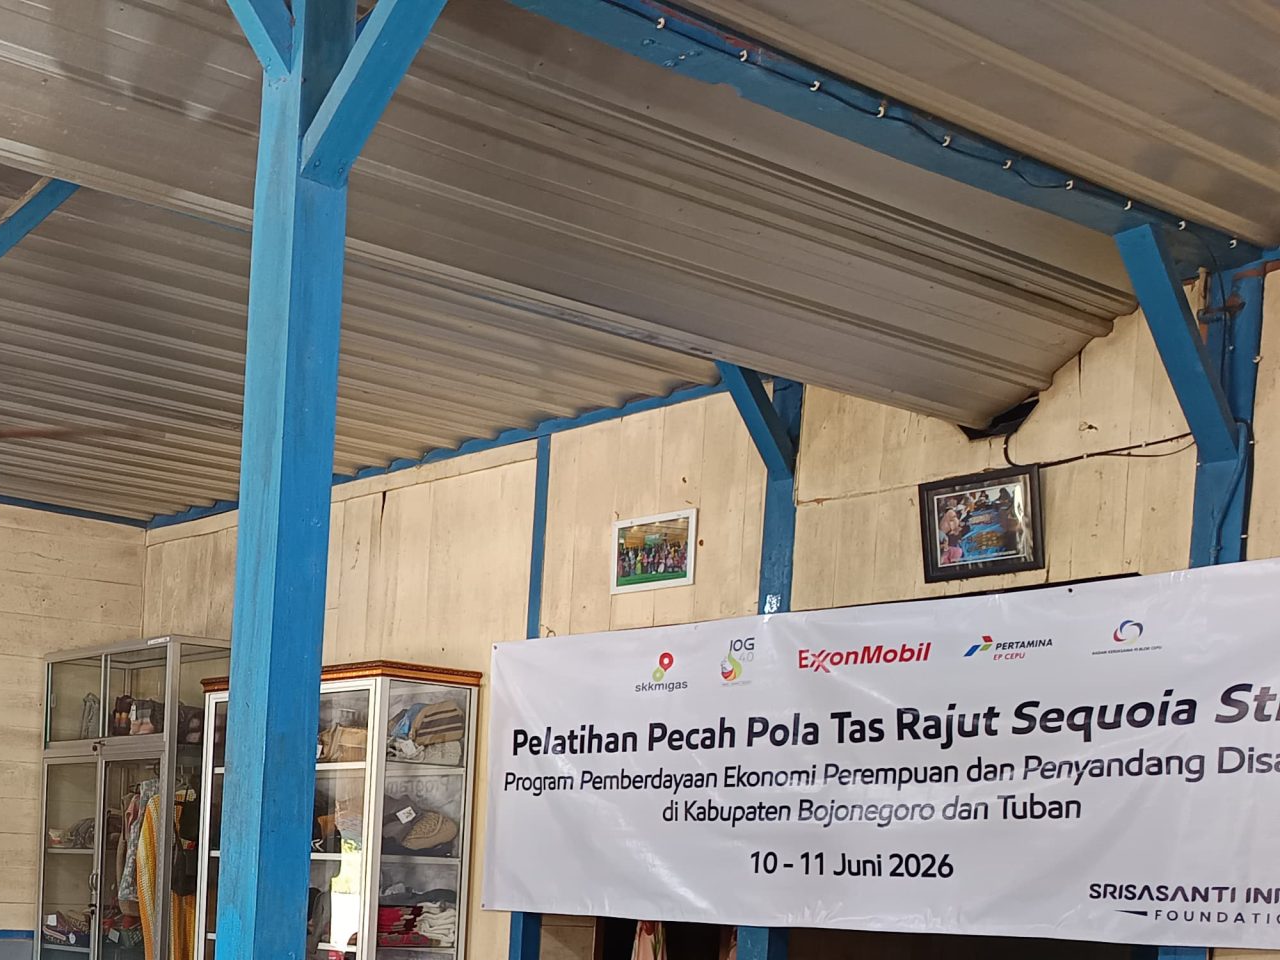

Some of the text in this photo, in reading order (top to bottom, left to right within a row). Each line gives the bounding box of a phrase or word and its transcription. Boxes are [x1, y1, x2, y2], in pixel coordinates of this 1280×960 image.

[993, 652, 1026, 661] EP CEPU
[995, 638, 1053, 651] PERTAMINA
[798, 642, 932, 673] ExxonMobil
[634, 679, 688, 693] skkmigas
[512, 683, 1280, 757] Pelatihan Pecah Pola Tas Rajut Sequoia St
[504, 772, 574, 797] Program
[579, 767, 718, 796] Pemberdayaan
[723, 764, 817, 788] Ekonomi
[823, 759, 959, 791] Perempuan
[966, 756, 1015, 784] dan
[1023, 748, 1205, 786] Penyandang
[662, 794, 1082, 828] di Kabupaten Bojonegoro dan Tuban
[749, 851, 778, 875] 10
[800, 852, 824, 876] 11
[833, 851, 883, 877] Juni
[889, 853, 955, 879] 2026
[1088, 883, 1237, 904] SRISASANTI
[1154, 909, 1280, 925] FOUNDATI
